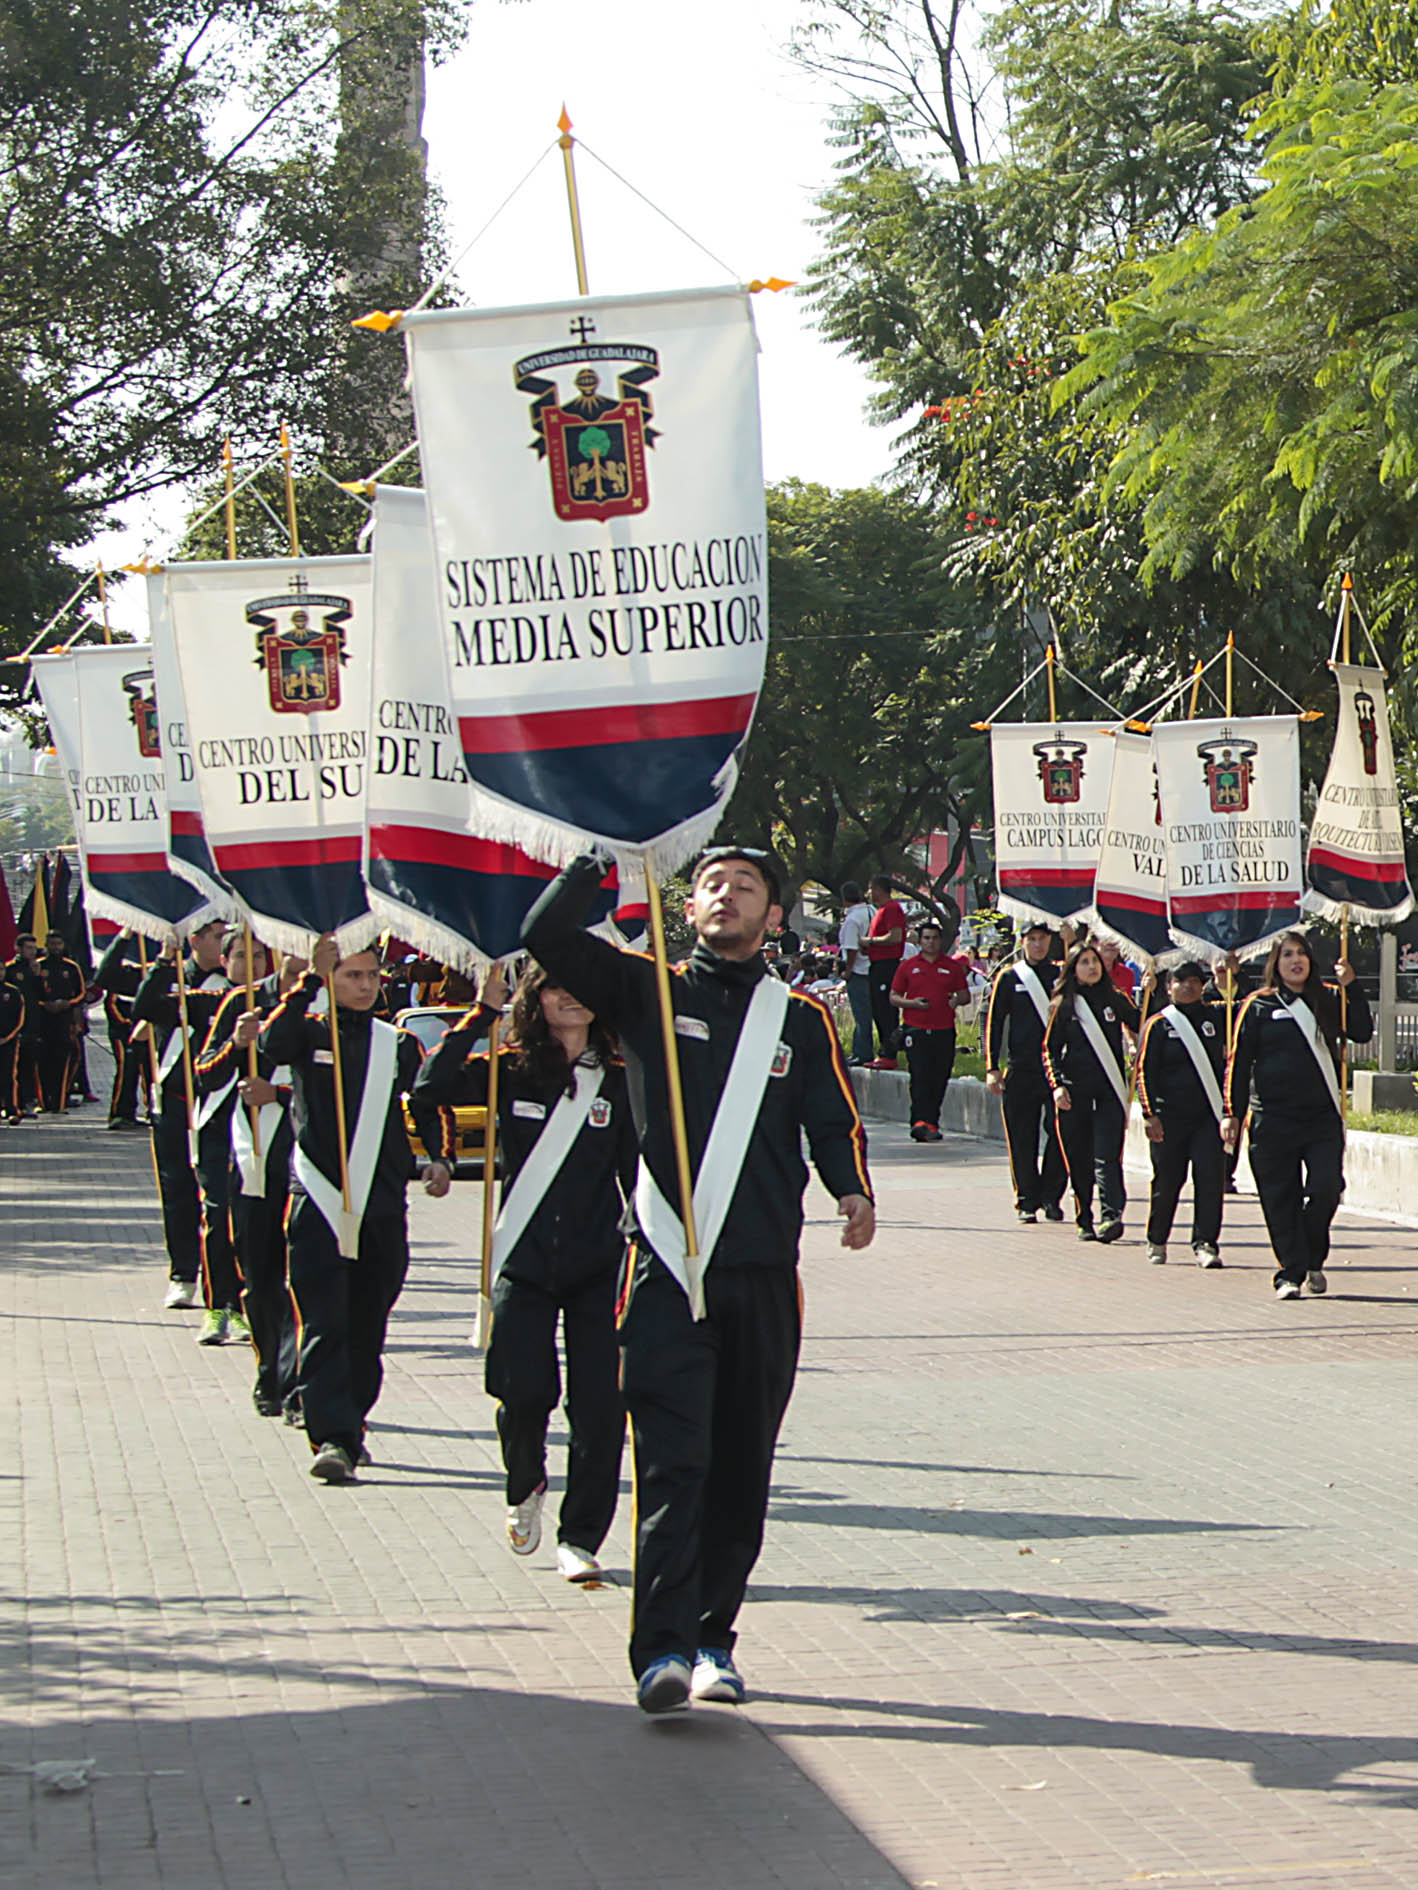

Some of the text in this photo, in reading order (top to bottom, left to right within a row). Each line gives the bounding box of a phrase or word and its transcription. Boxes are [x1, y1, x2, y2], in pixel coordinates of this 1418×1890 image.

[518, 351, 576, 373] UNIVERSIDAD
[588, 347, 655, 363] GUADALAJARA
[446, 533, 762, 608] SISTEMA DE EDUCACION
[452, 594, 764, 667] MEDIA SUPERIOR
[379, 699, 453, 735] CENTR
[199, 735, 275, 769] CENTRO
[375, 735, 422, 778] DE
[85, 773, 141, 794] CENTRO
[238, 763, 364, 804] DEL SU
[86, 796, 159, 822] DE LA
[1000, 812, 1041, 827] CENTRO
[1007, 828, 1065, 849] CAMPUS
[1107, 830, 1150, 852] CENTRO
[1169, 819, 1297, 844] CENTRO UNIVERSITARIO
[1202, 840, 1265, 861] DE CIENCIAS
[1132, 852, 1167, 879] VAL
[1181, 860, 1289, 886] DE LA SALUD
